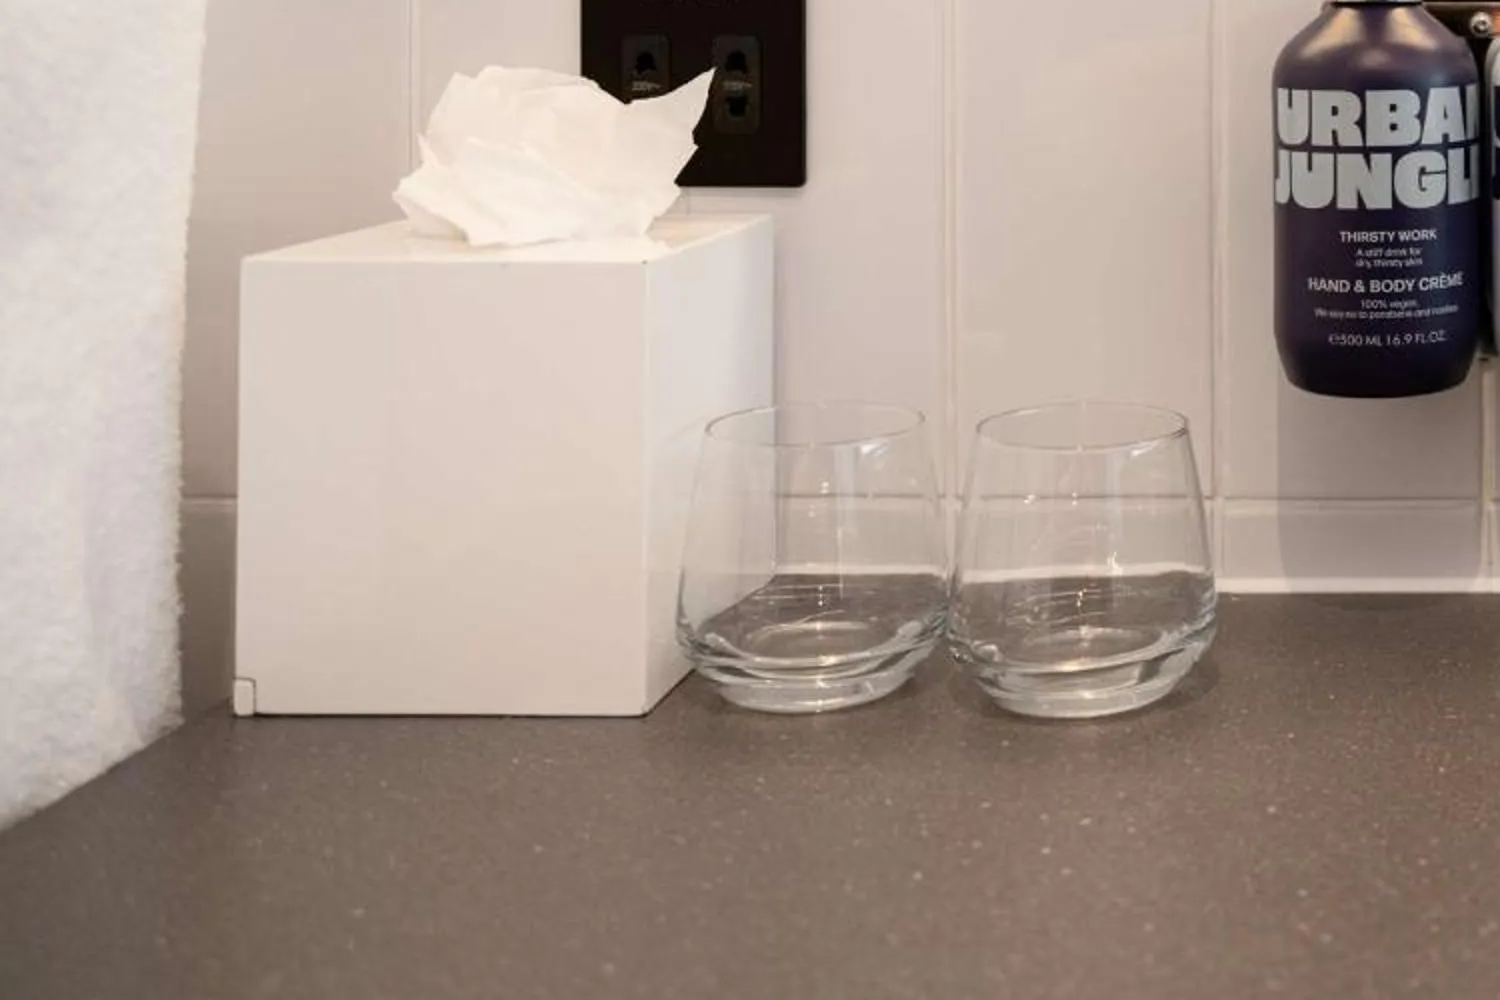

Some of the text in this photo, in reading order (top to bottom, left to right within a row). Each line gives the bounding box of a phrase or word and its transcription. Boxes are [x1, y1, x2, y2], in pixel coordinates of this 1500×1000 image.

[1339, 228, 1437, 243] THIRSTY WORK
[1307, 271, 1465, 293] HAND & BODY CRÈME
[1361, 299, 1388, 310] 100%
[1365, 335, 1383, 347] ML
[1386, 333, 1414, 346] 16.9
